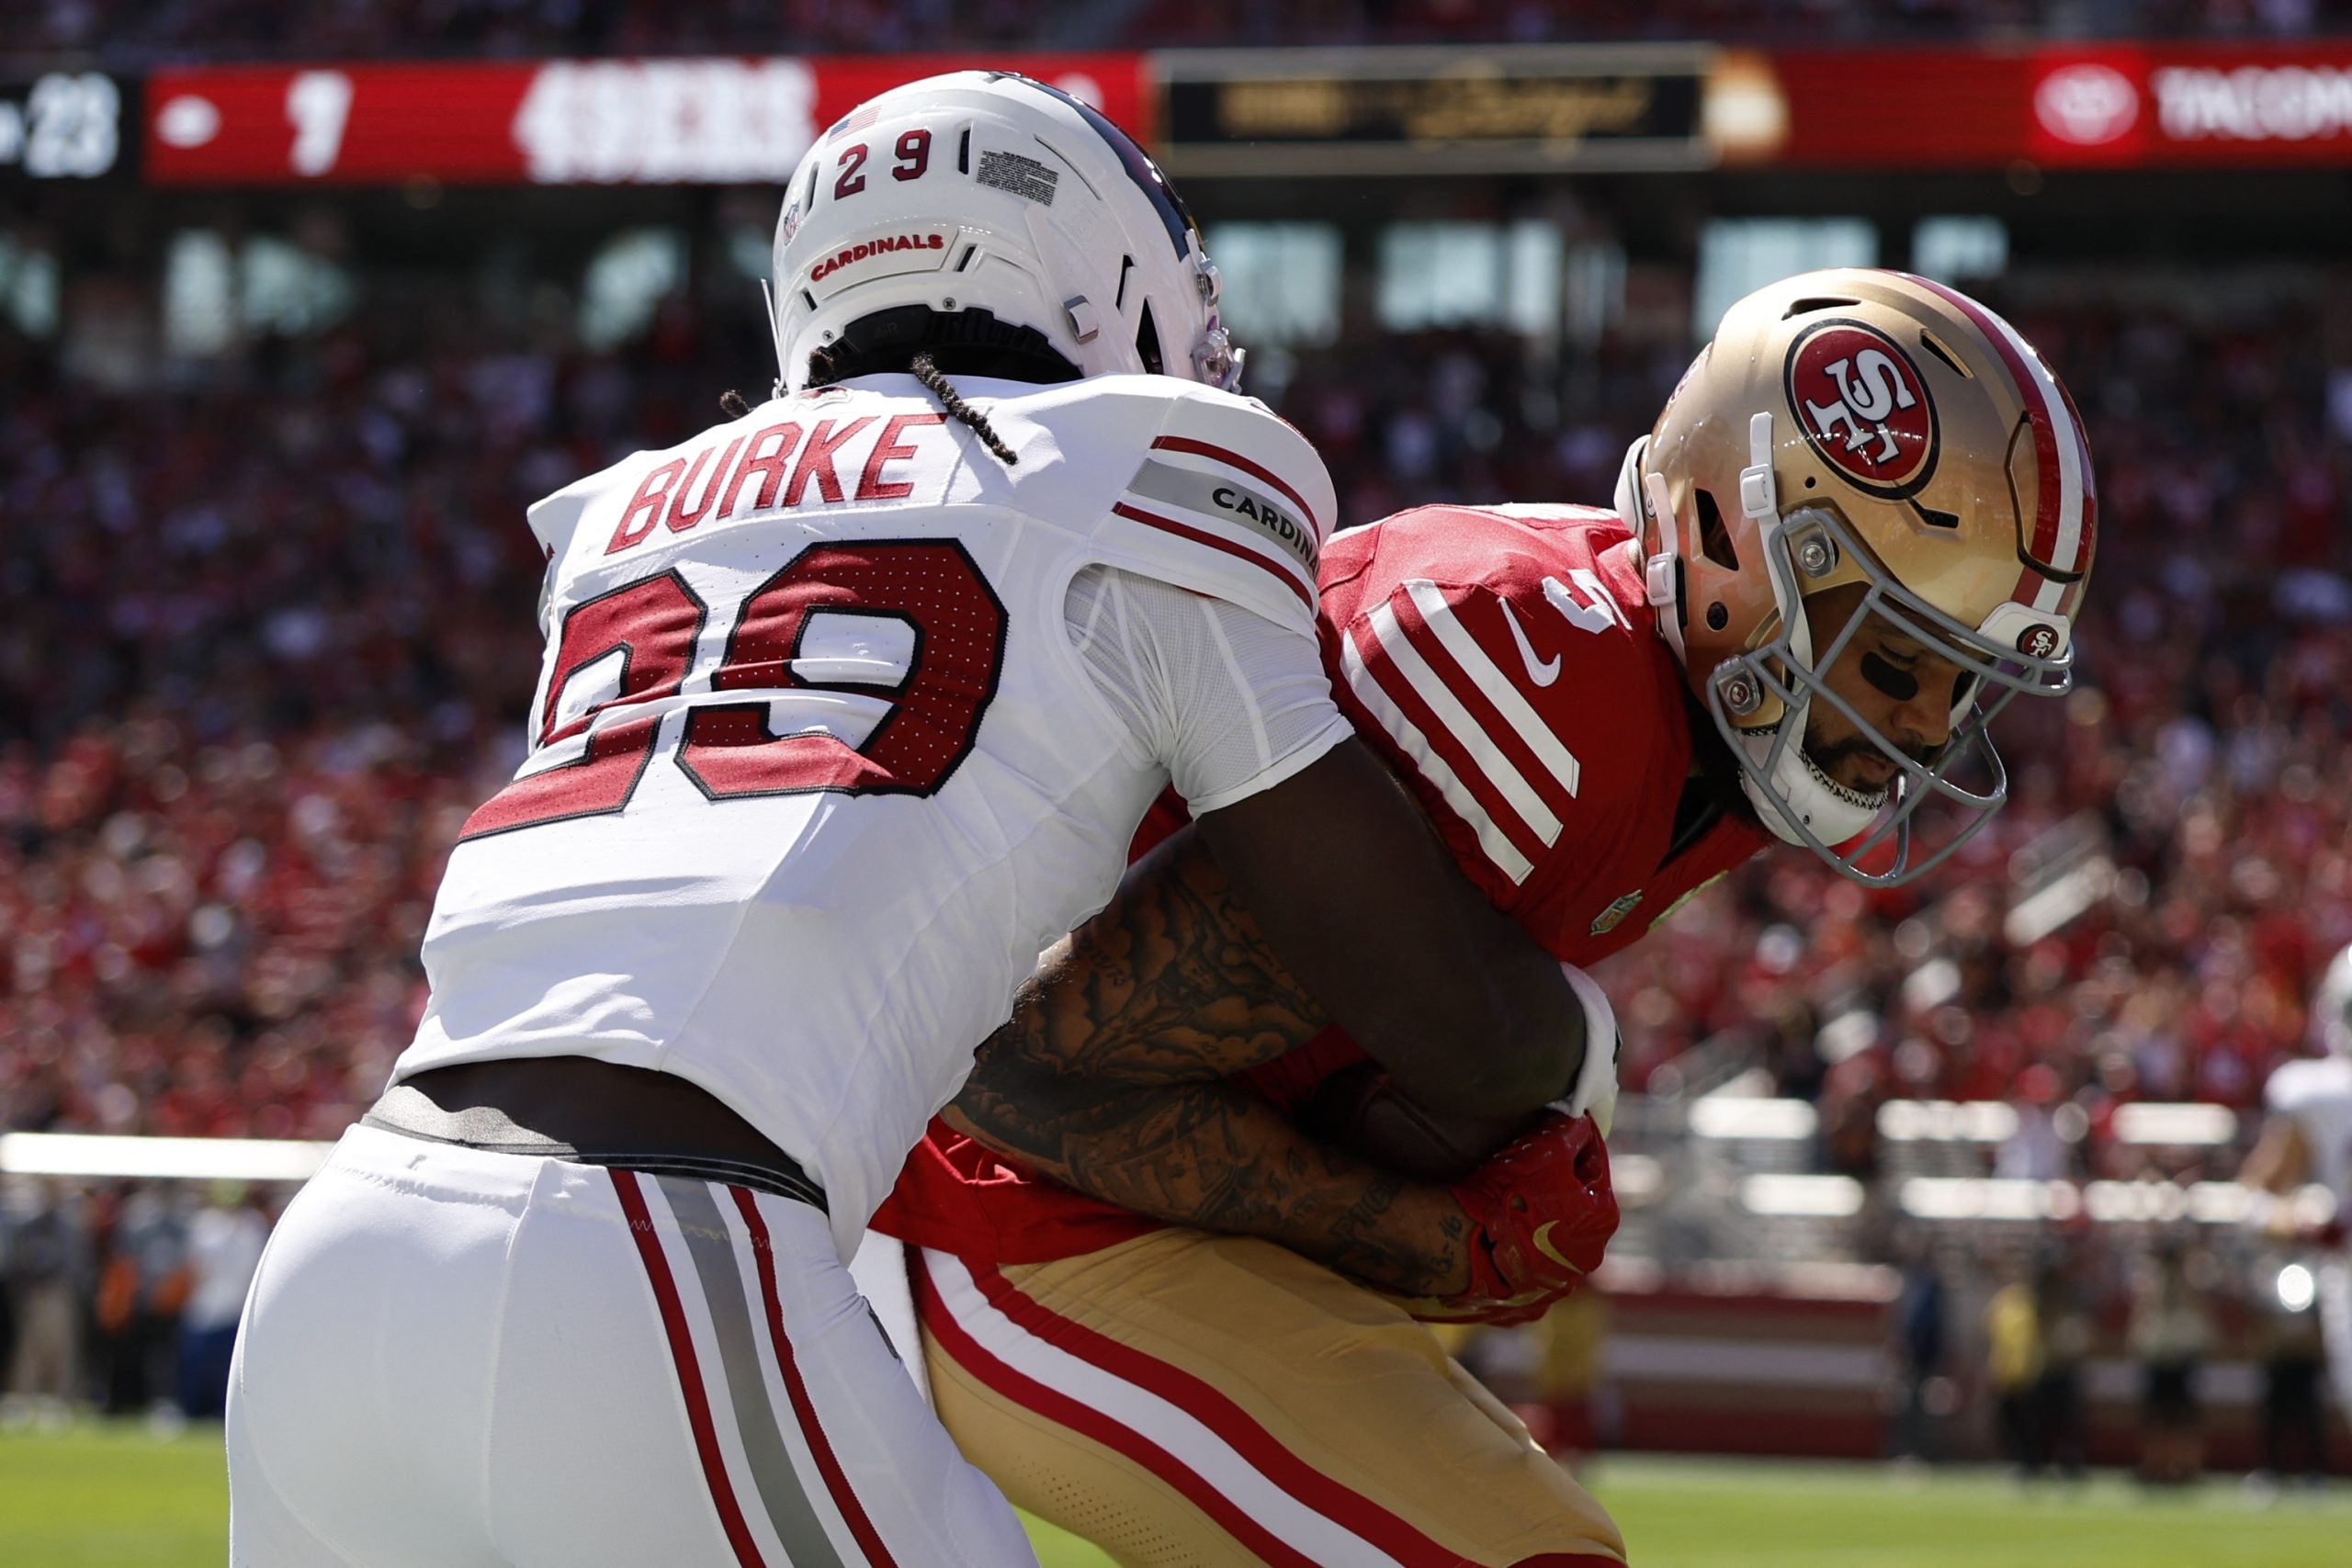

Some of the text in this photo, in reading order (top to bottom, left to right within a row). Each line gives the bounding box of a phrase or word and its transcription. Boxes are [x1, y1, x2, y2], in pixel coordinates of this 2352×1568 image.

[810, 233, 944, 282] CARDINALS
[605, 412, 948, 557] BURKE
[458, 536, 1010, 843] 29
